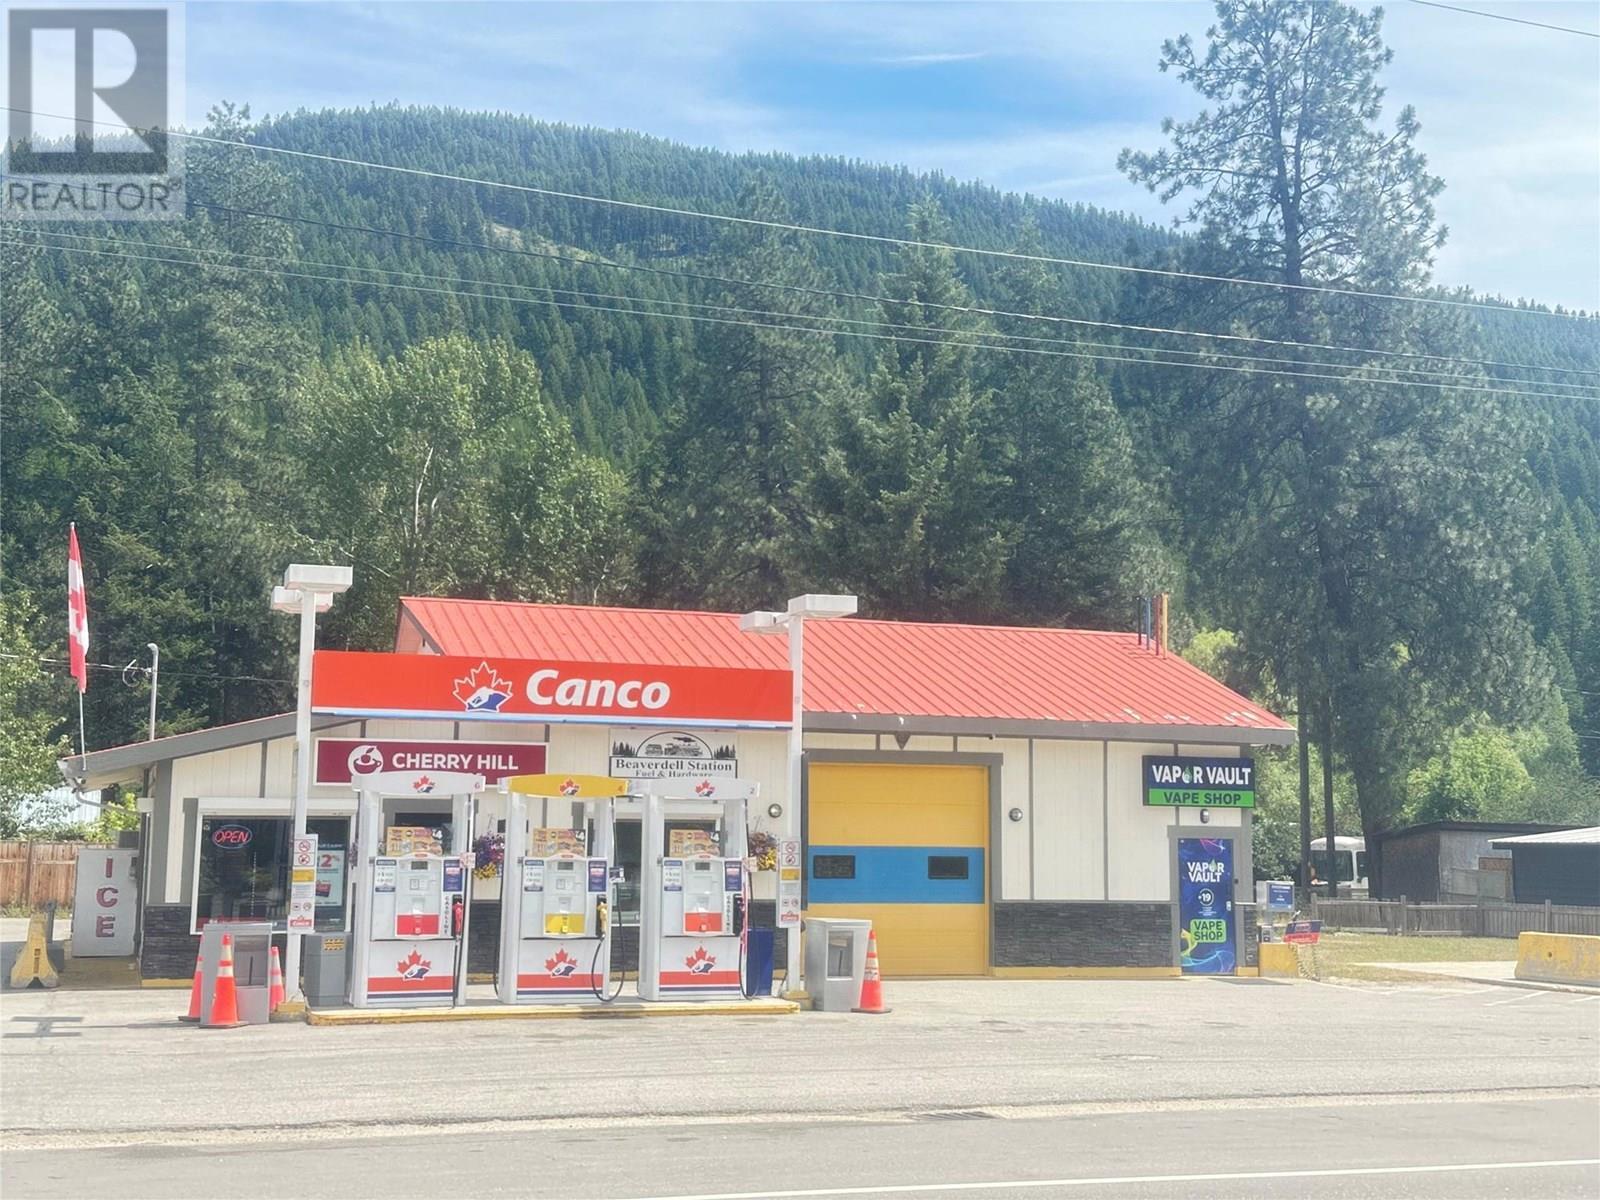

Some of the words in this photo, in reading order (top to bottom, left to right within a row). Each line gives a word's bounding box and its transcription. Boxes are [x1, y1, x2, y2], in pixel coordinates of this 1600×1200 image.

[526, 669, 671, 709] Canco
[392, 753, 474, 769] CHERRY
[477, 754, 519, 770] HILL
[615, 758, 684, 770] Beaverdell
[687, 760, 732, 772] Station
[668, 770, 713, 778] Hardware
[1206, 766, 1252, 785] VAULT
[1164, 791, 1200, 804] VAPE
[1204, 793, 1241, 805] SHOP
[214, 830, 249, 843] OPEN
[1188, 872, 1222, 882] VAULT
[96, 857, 119, 938] ICE
[1194, 921, 1223, 930] VAPE
[1194, 931, 1223, 940] SHOP
